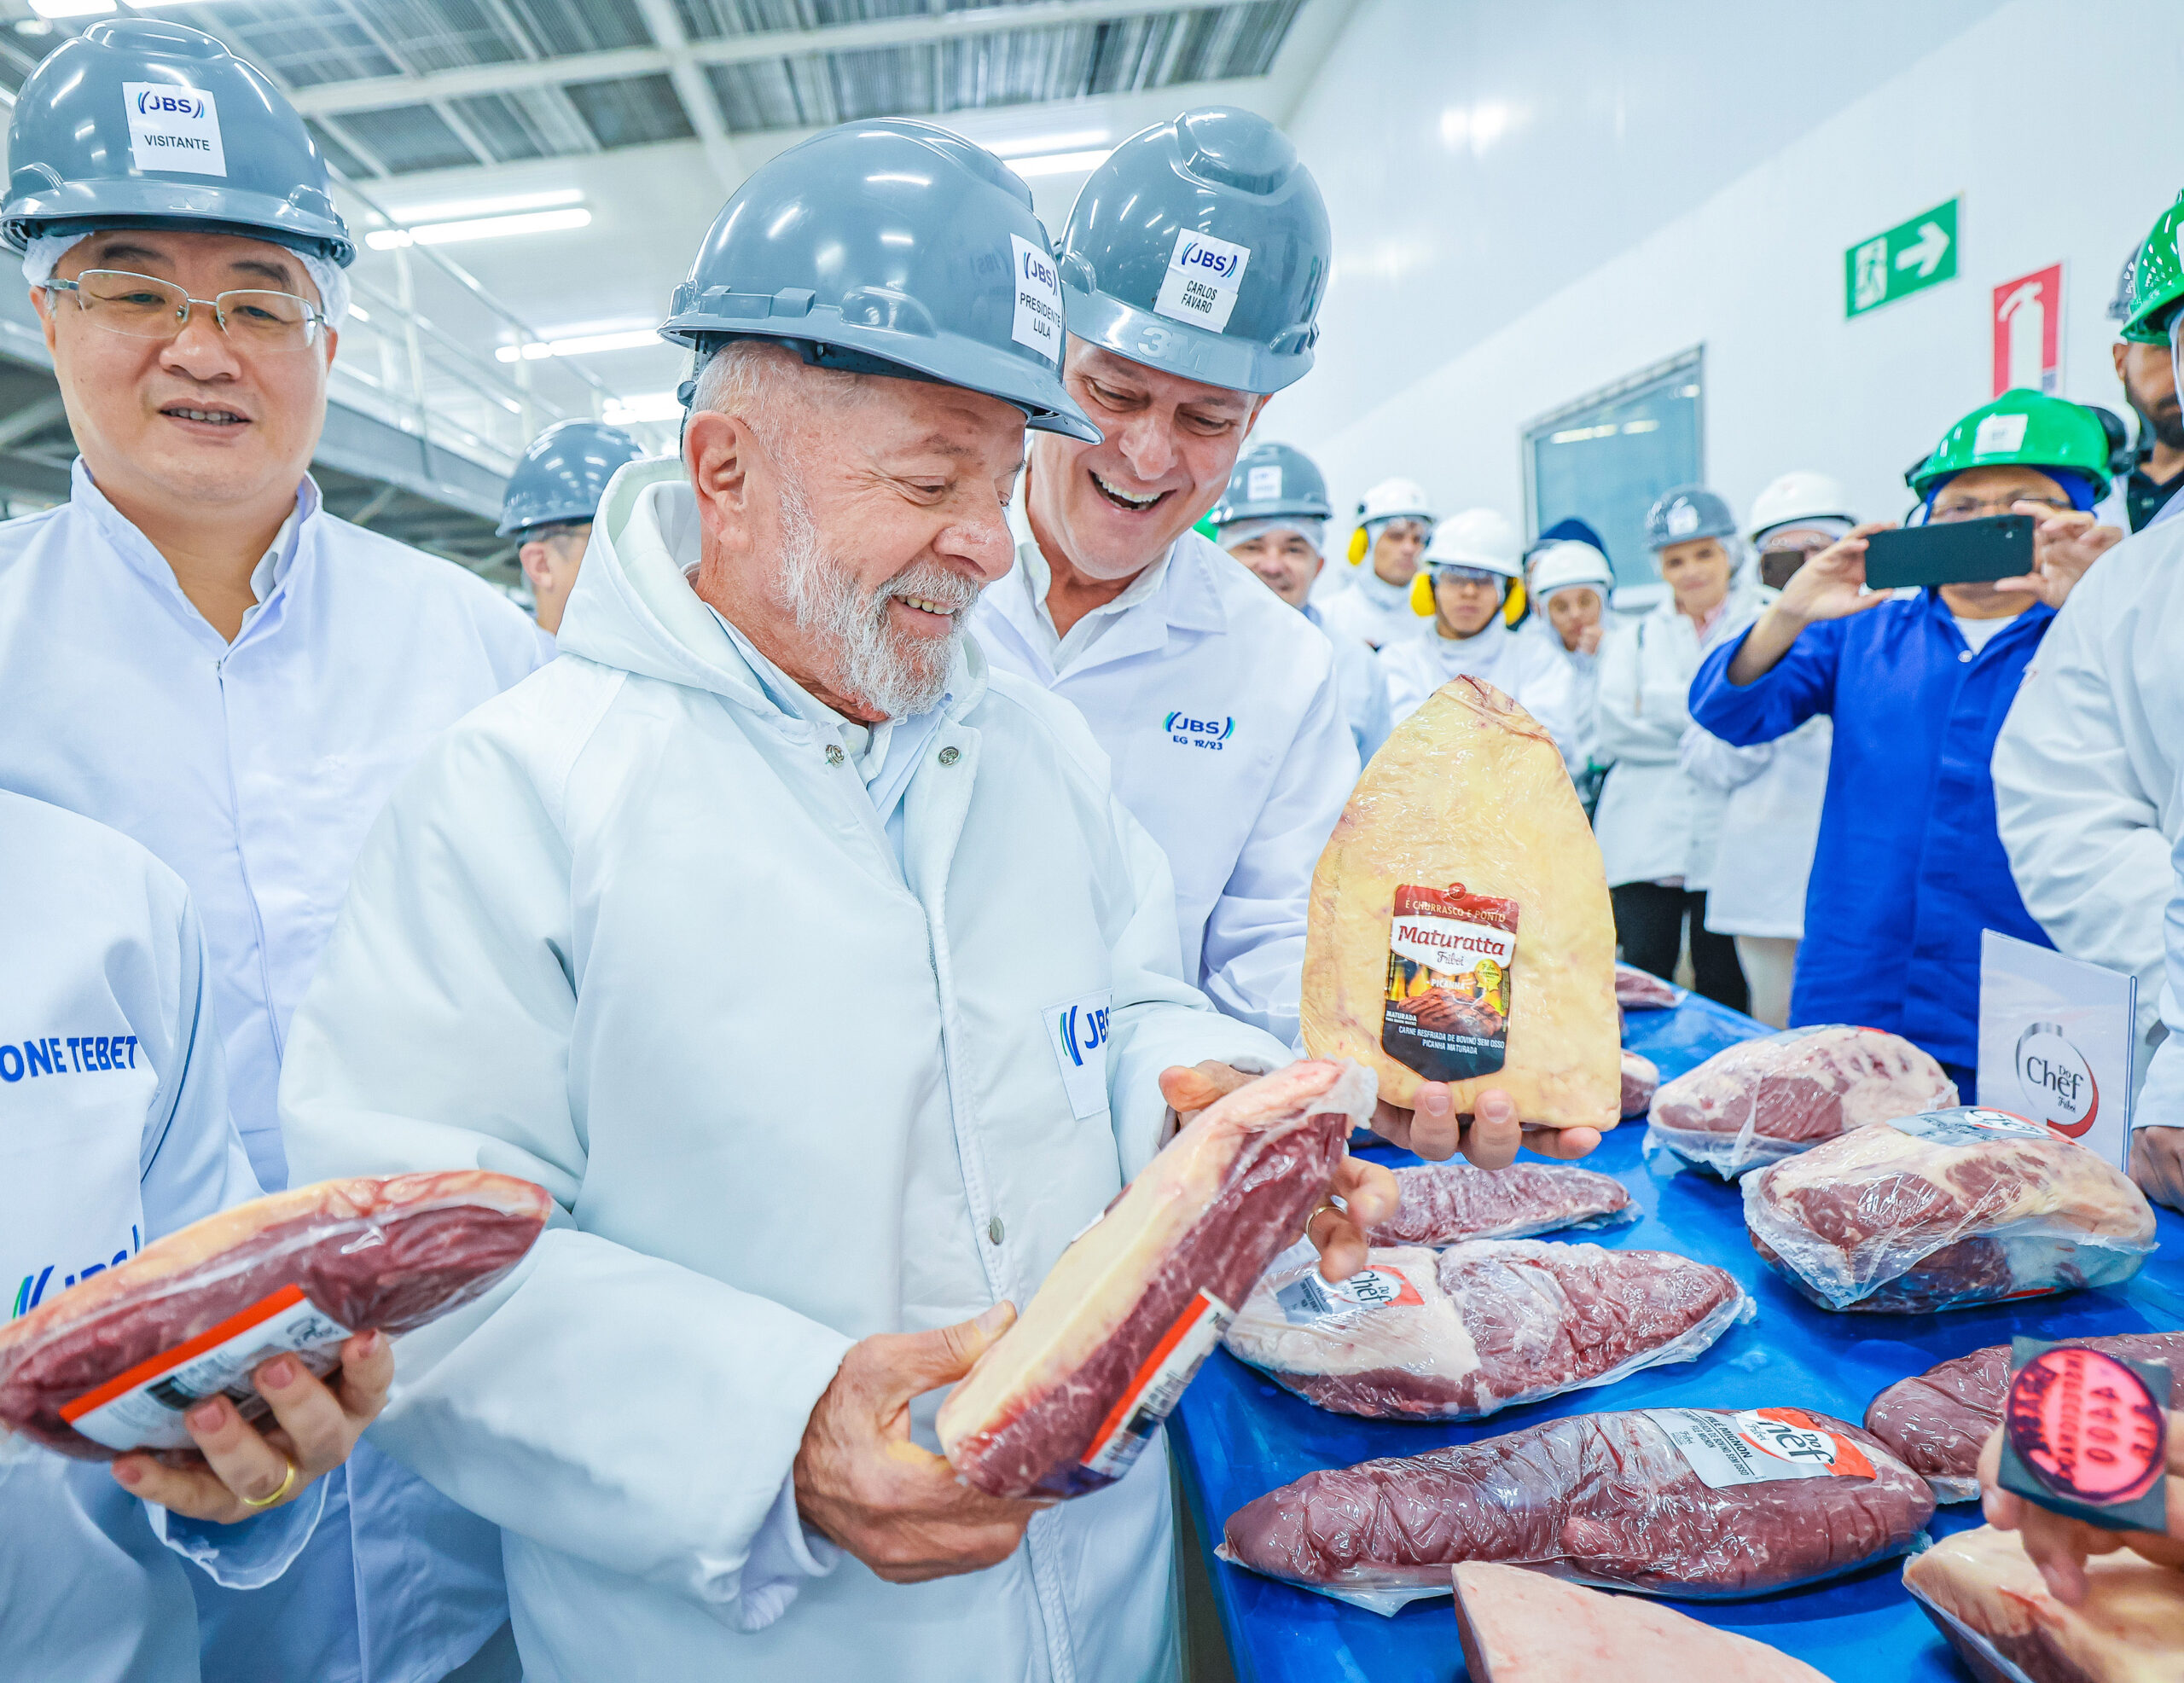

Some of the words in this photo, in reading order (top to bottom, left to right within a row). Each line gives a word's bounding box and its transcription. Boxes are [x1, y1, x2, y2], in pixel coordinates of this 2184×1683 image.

[144, 135, 211, 151] VISITANTE
[1186, 280, 1218, 301] CARLOS
[1019, 292, 1061, 328] PRESIDENTE
[1181, 293, 1213, 314] FAVARO
[1033, 317, 1052, 340] LULA
[1173, 734, 1188, 745] EG
[1412, 900, 1465, 917] CHURRASCO
[1474, 909, 1507, 923] PONTO
[1397, 925, 1506, 956] Maturatta
[1437, 950, 1465, 966] Friboi
[1431, 978, 1466, 991] PICANHA
[1385, 1010, 1418, 1022] MATURADA
[1398, 1025, 1416, 1036] CARNE
[1417, 1029, 1447, 1042] RESFRIADA
[1448, 1034, 1455, 1042] DE
[1456, 1035, 1477, 1045] BOVINO
[1477, 1038, 1490, 1048] SEM
[1490, 1040, 1505, 1049] OSSO
[1422, 1038, 1446, 1050] PICANHA
[1447, 1042, 1478, 1055] MATURADA
[0, 1038, 67, 1082] ONE
[67, 1035, 138, 1073] TEBET
[2027, 1057, 2084, 1100] Chef
[2059, 1065, 2071, 1078] Do
[1704, 1416, 1728, 1428] FILÉ
[1718, 1427, 1754, 1459] MIGNON
[1801, 1433, 1821, 1448] Do
